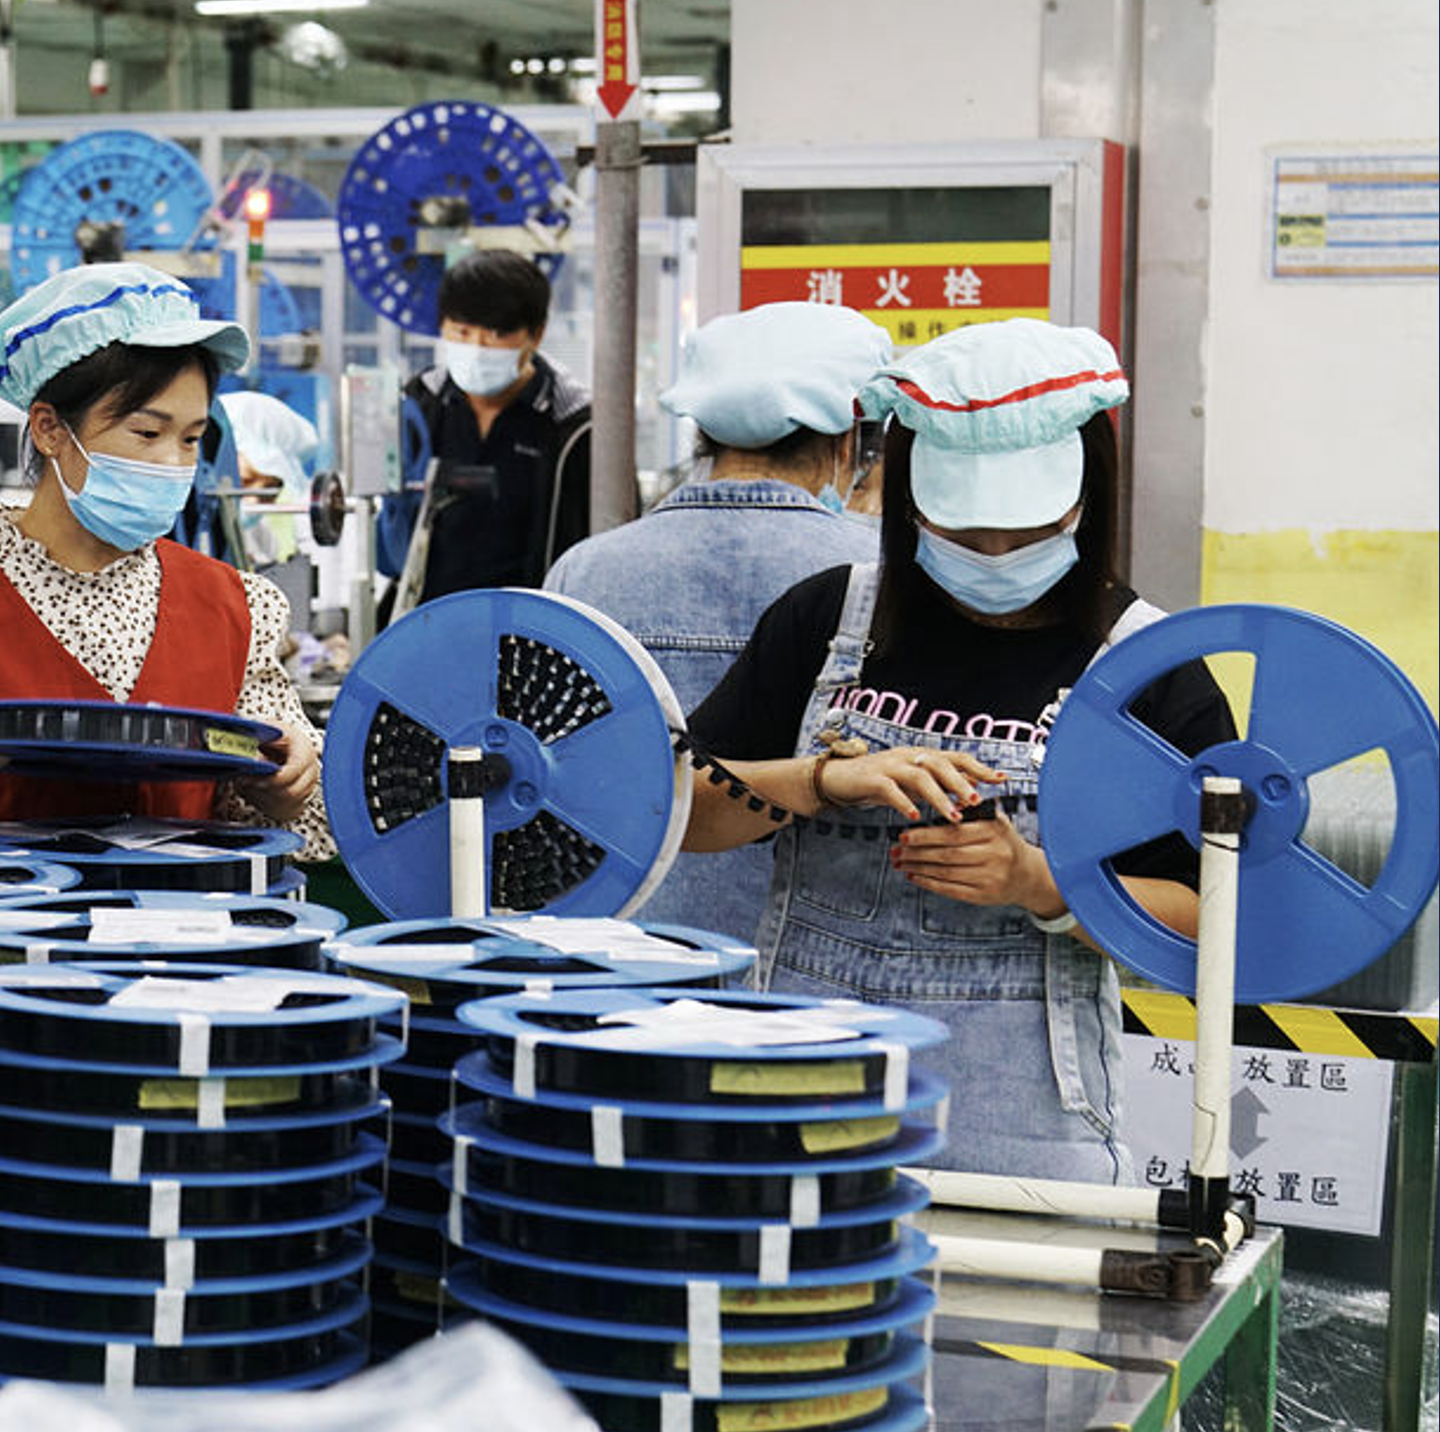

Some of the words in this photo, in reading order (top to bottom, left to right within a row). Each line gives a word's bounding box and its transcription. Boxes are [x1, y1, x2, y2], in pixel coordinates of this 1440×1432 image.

[806, 267, 982, 307] 消火栓
[1150, 1043, 1348, 1092] 成放置區
